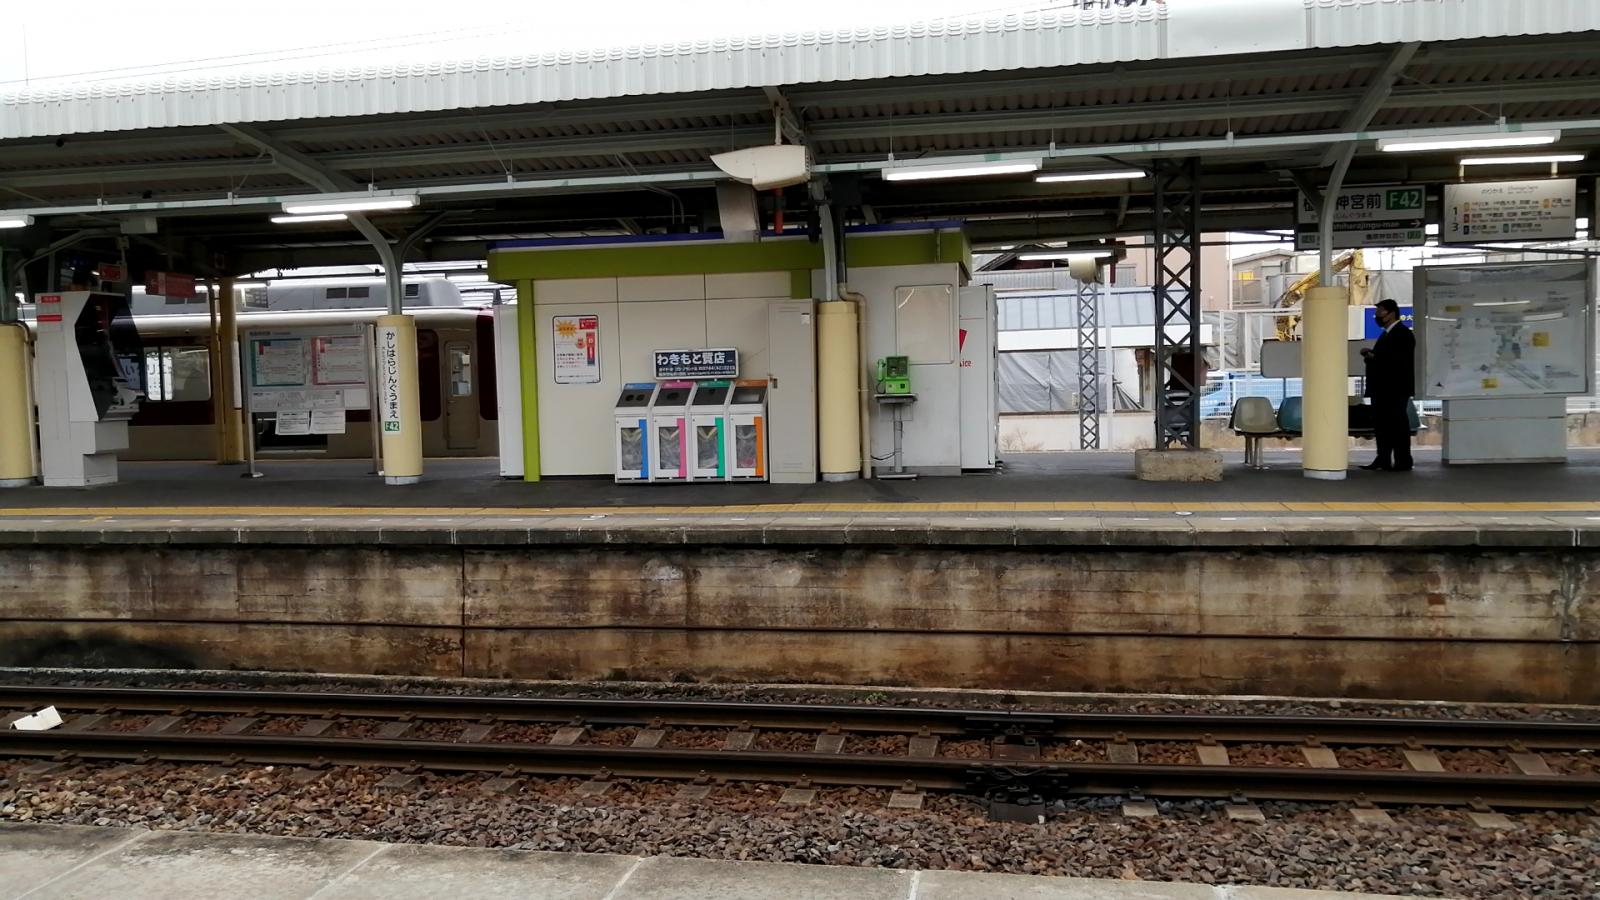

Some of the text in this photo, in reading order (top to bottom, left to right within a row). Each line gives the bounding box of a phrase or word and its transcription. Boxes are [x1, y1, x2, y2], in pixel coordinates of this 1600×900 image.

[1390, 191, 1420, 208] F42
[386, 331, 398, 418] かしはらじんぐうまえ
[385, 422, 399, 431] F42
